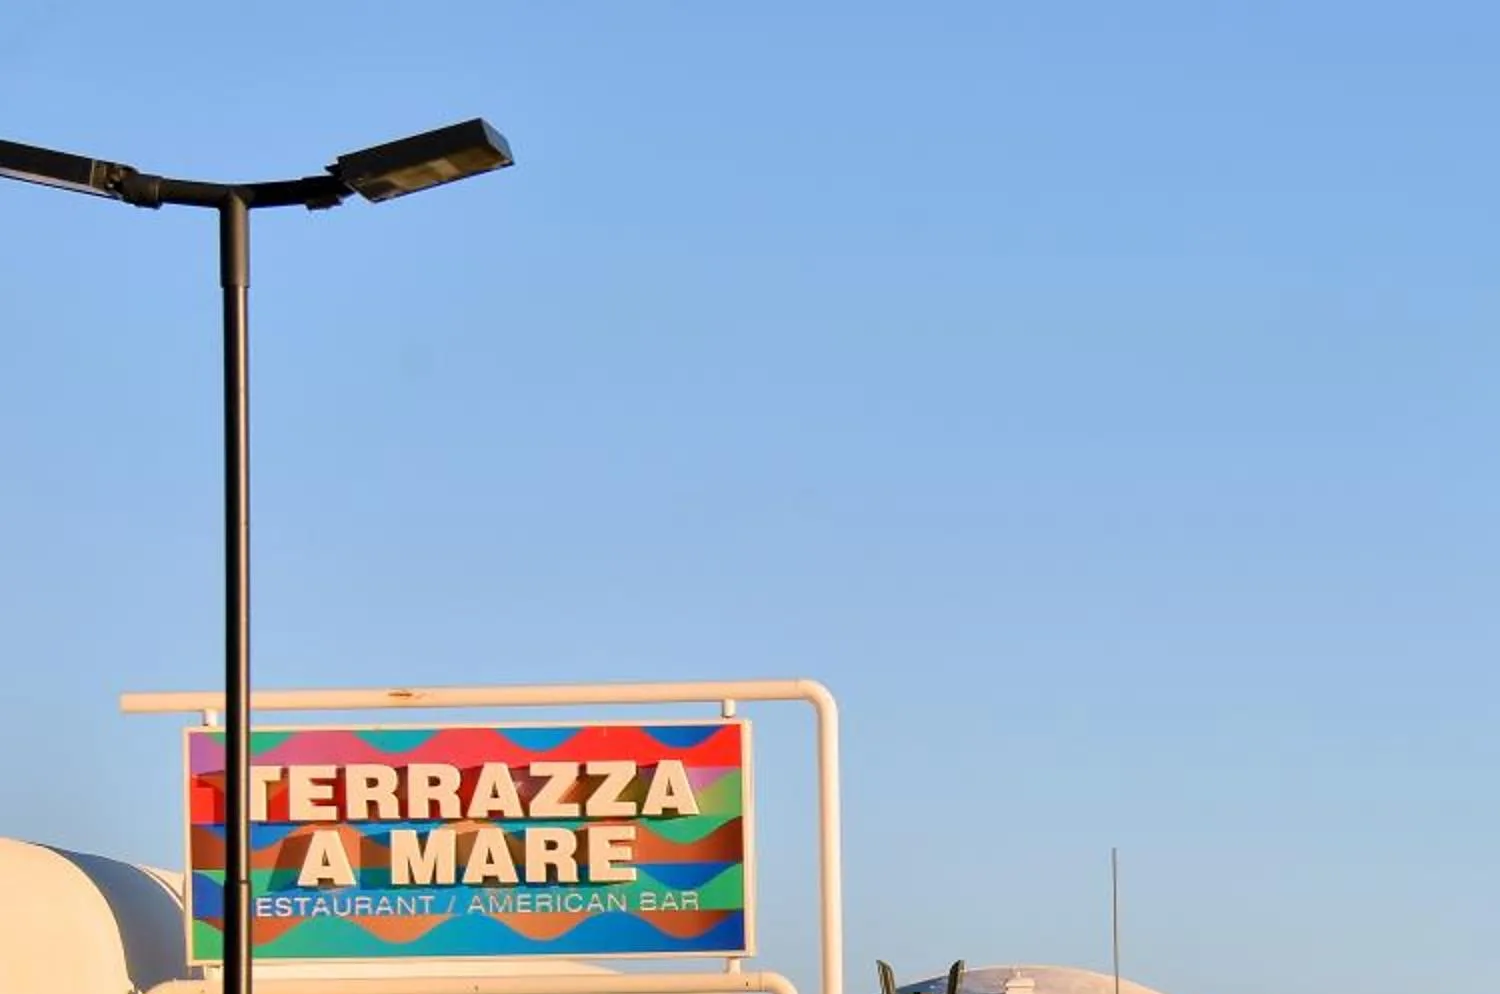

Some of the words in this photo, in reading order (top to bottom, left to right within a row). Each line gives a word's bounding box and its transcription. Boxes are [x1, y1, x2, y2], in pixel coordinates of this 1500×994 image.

[250, 760, 700, 822] TERRAZZA
[298, 829, 357, 887] A
[390, 825, 637, 885] MARE
[255, 895, 436, 918] ESTAURANT
[467, 892, 627, 914] AMERICAN
[639, 891, 700, 912] BAR
